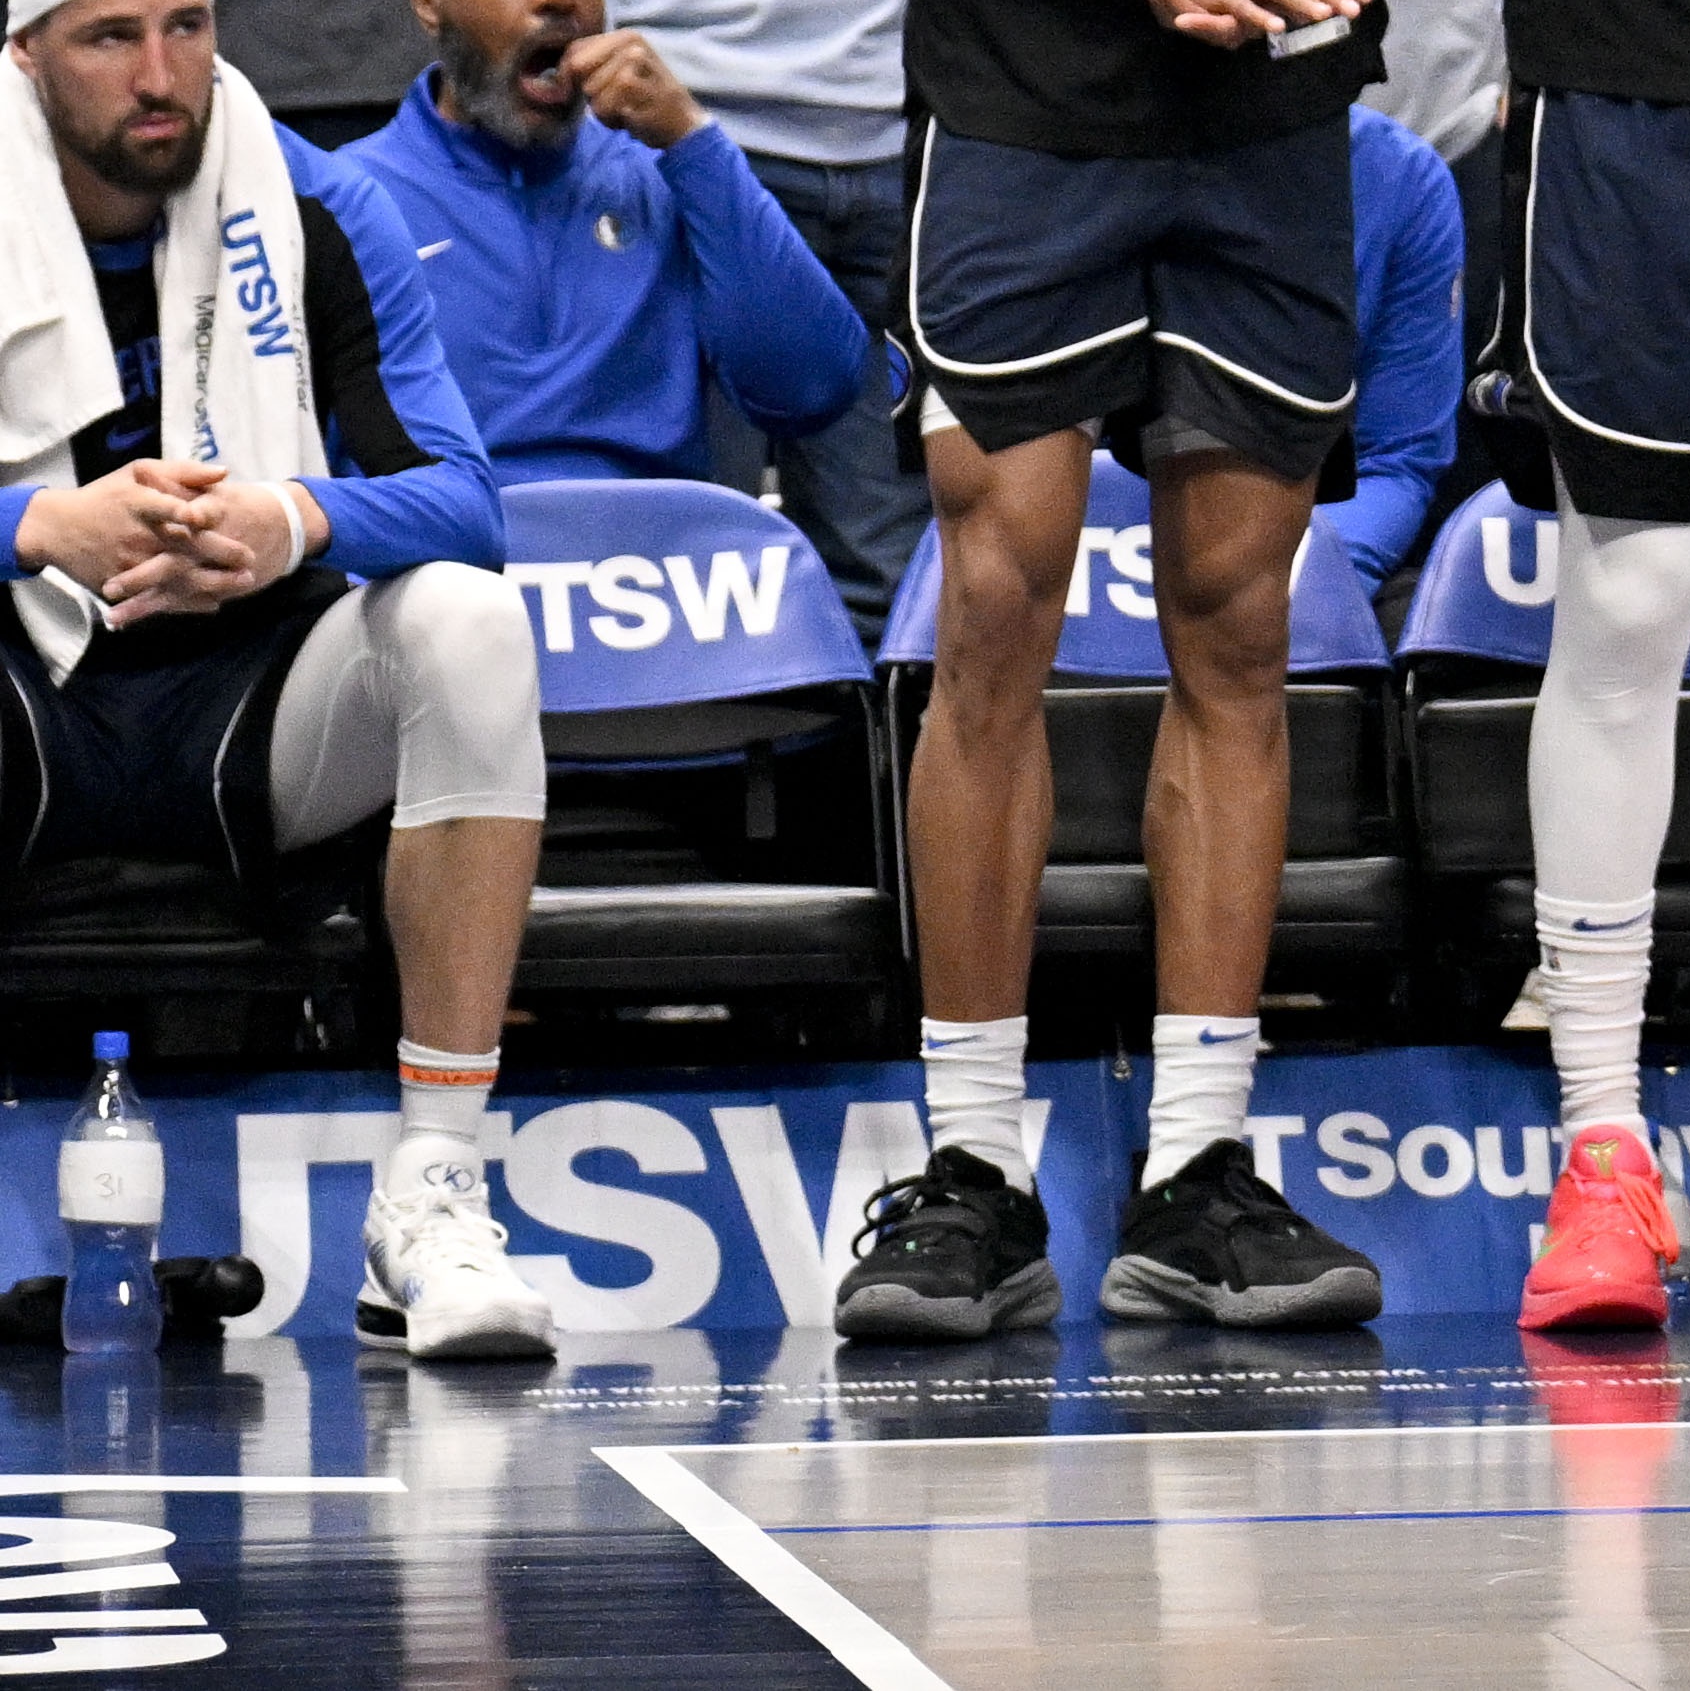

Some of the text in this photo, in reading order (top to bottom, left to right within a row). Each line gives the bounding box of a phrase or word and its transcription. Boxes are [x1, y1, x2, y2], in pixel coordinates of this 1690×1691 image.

[219, 208, 294, 358] UTSW
[502, 545, 791, 654] TSW
[94, 1172, 123, 1199] 31
